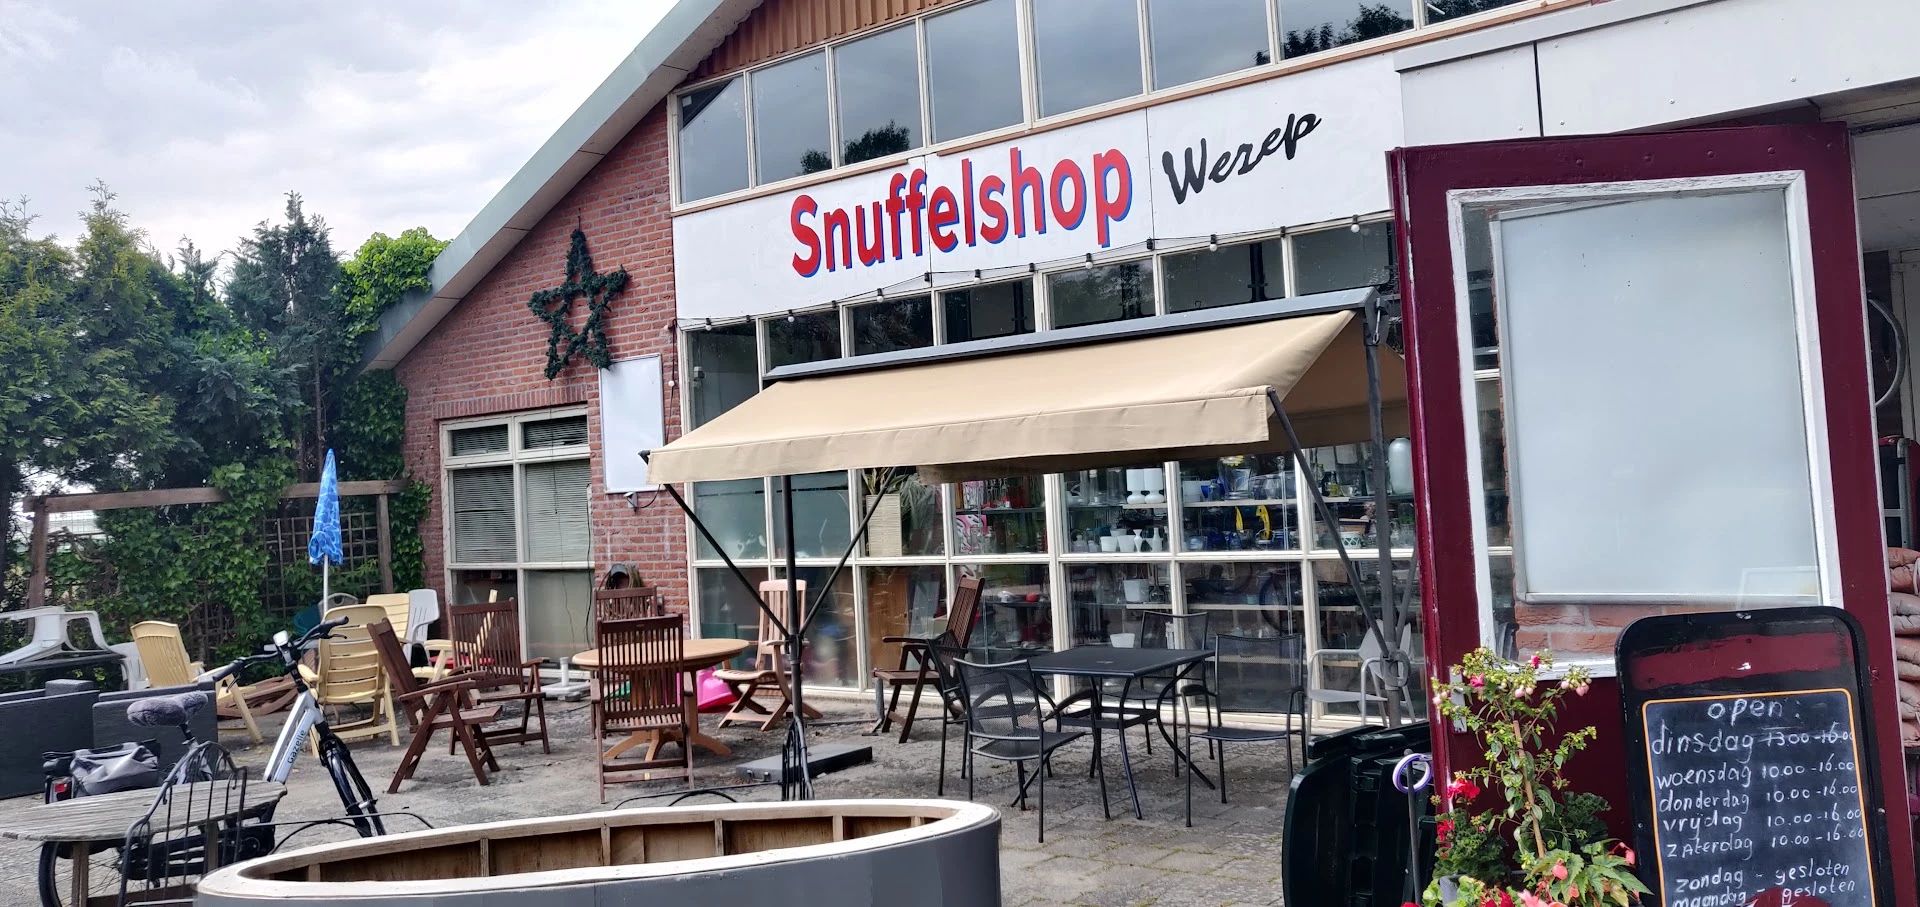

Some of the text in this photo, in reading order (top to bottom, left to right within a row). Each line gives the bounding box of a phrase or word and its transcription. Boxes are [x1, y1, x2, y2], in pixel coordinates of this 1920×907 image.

[790, 113, 1322, 278] Snuffelshop Wezep
[287, 729, 307, 764] Gazelle
[1651, 719, 1753, 763] dinsdag
[1656, 762, 1752, 788] woensdag
[1659, 789, 1750, 815] donderdag
[1673, 885, 1747, 907] maandag
[1781, 876, 1855, 906] gesloten
[1675, 866, 1743, 893] zondag
[1775, 858, 1850, 886] gesloten
